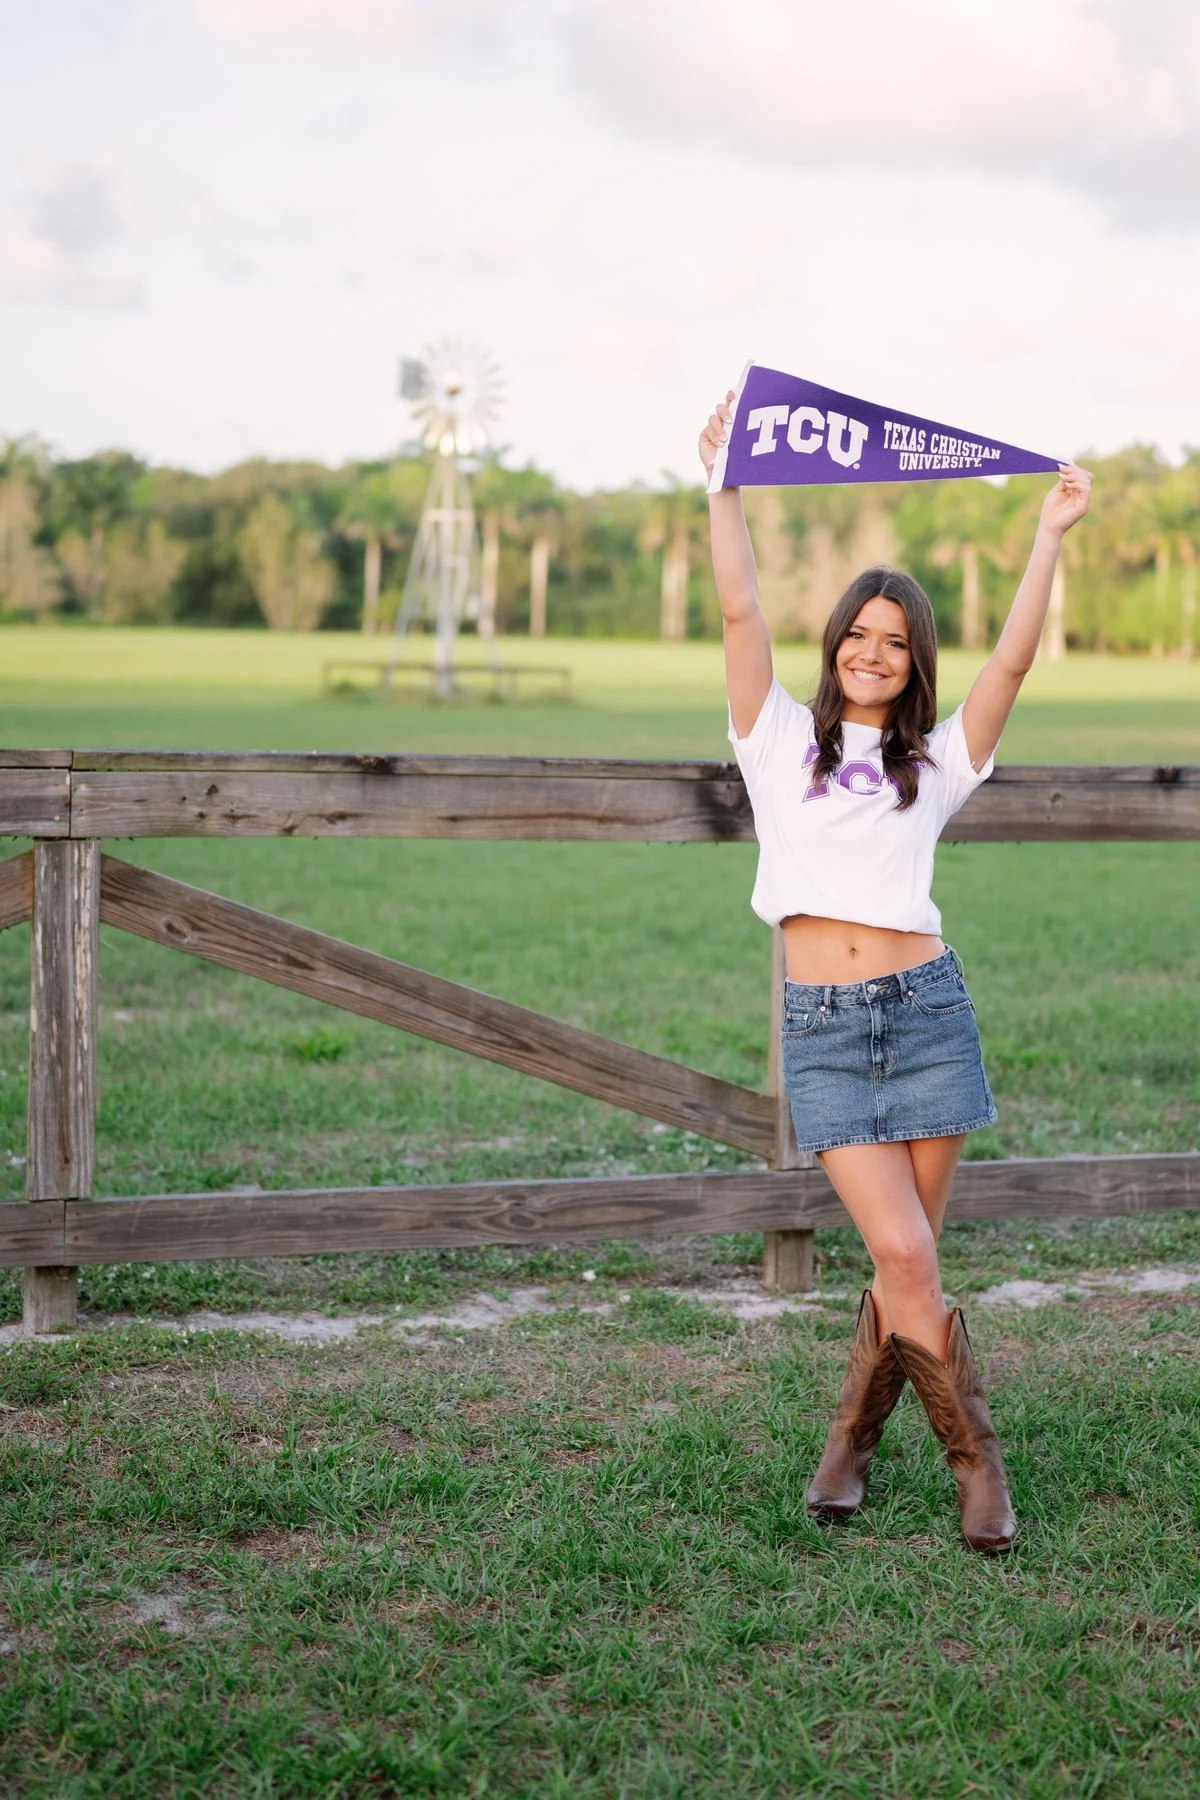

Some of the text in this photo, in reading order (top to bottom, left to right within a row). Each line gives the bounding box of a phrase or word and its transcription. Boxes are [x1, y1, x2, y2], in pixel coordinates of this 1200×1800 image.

[746, 404, 869, 468] TCU
[883, 420, 1001, 460] TEXAS CHRISTIAN
